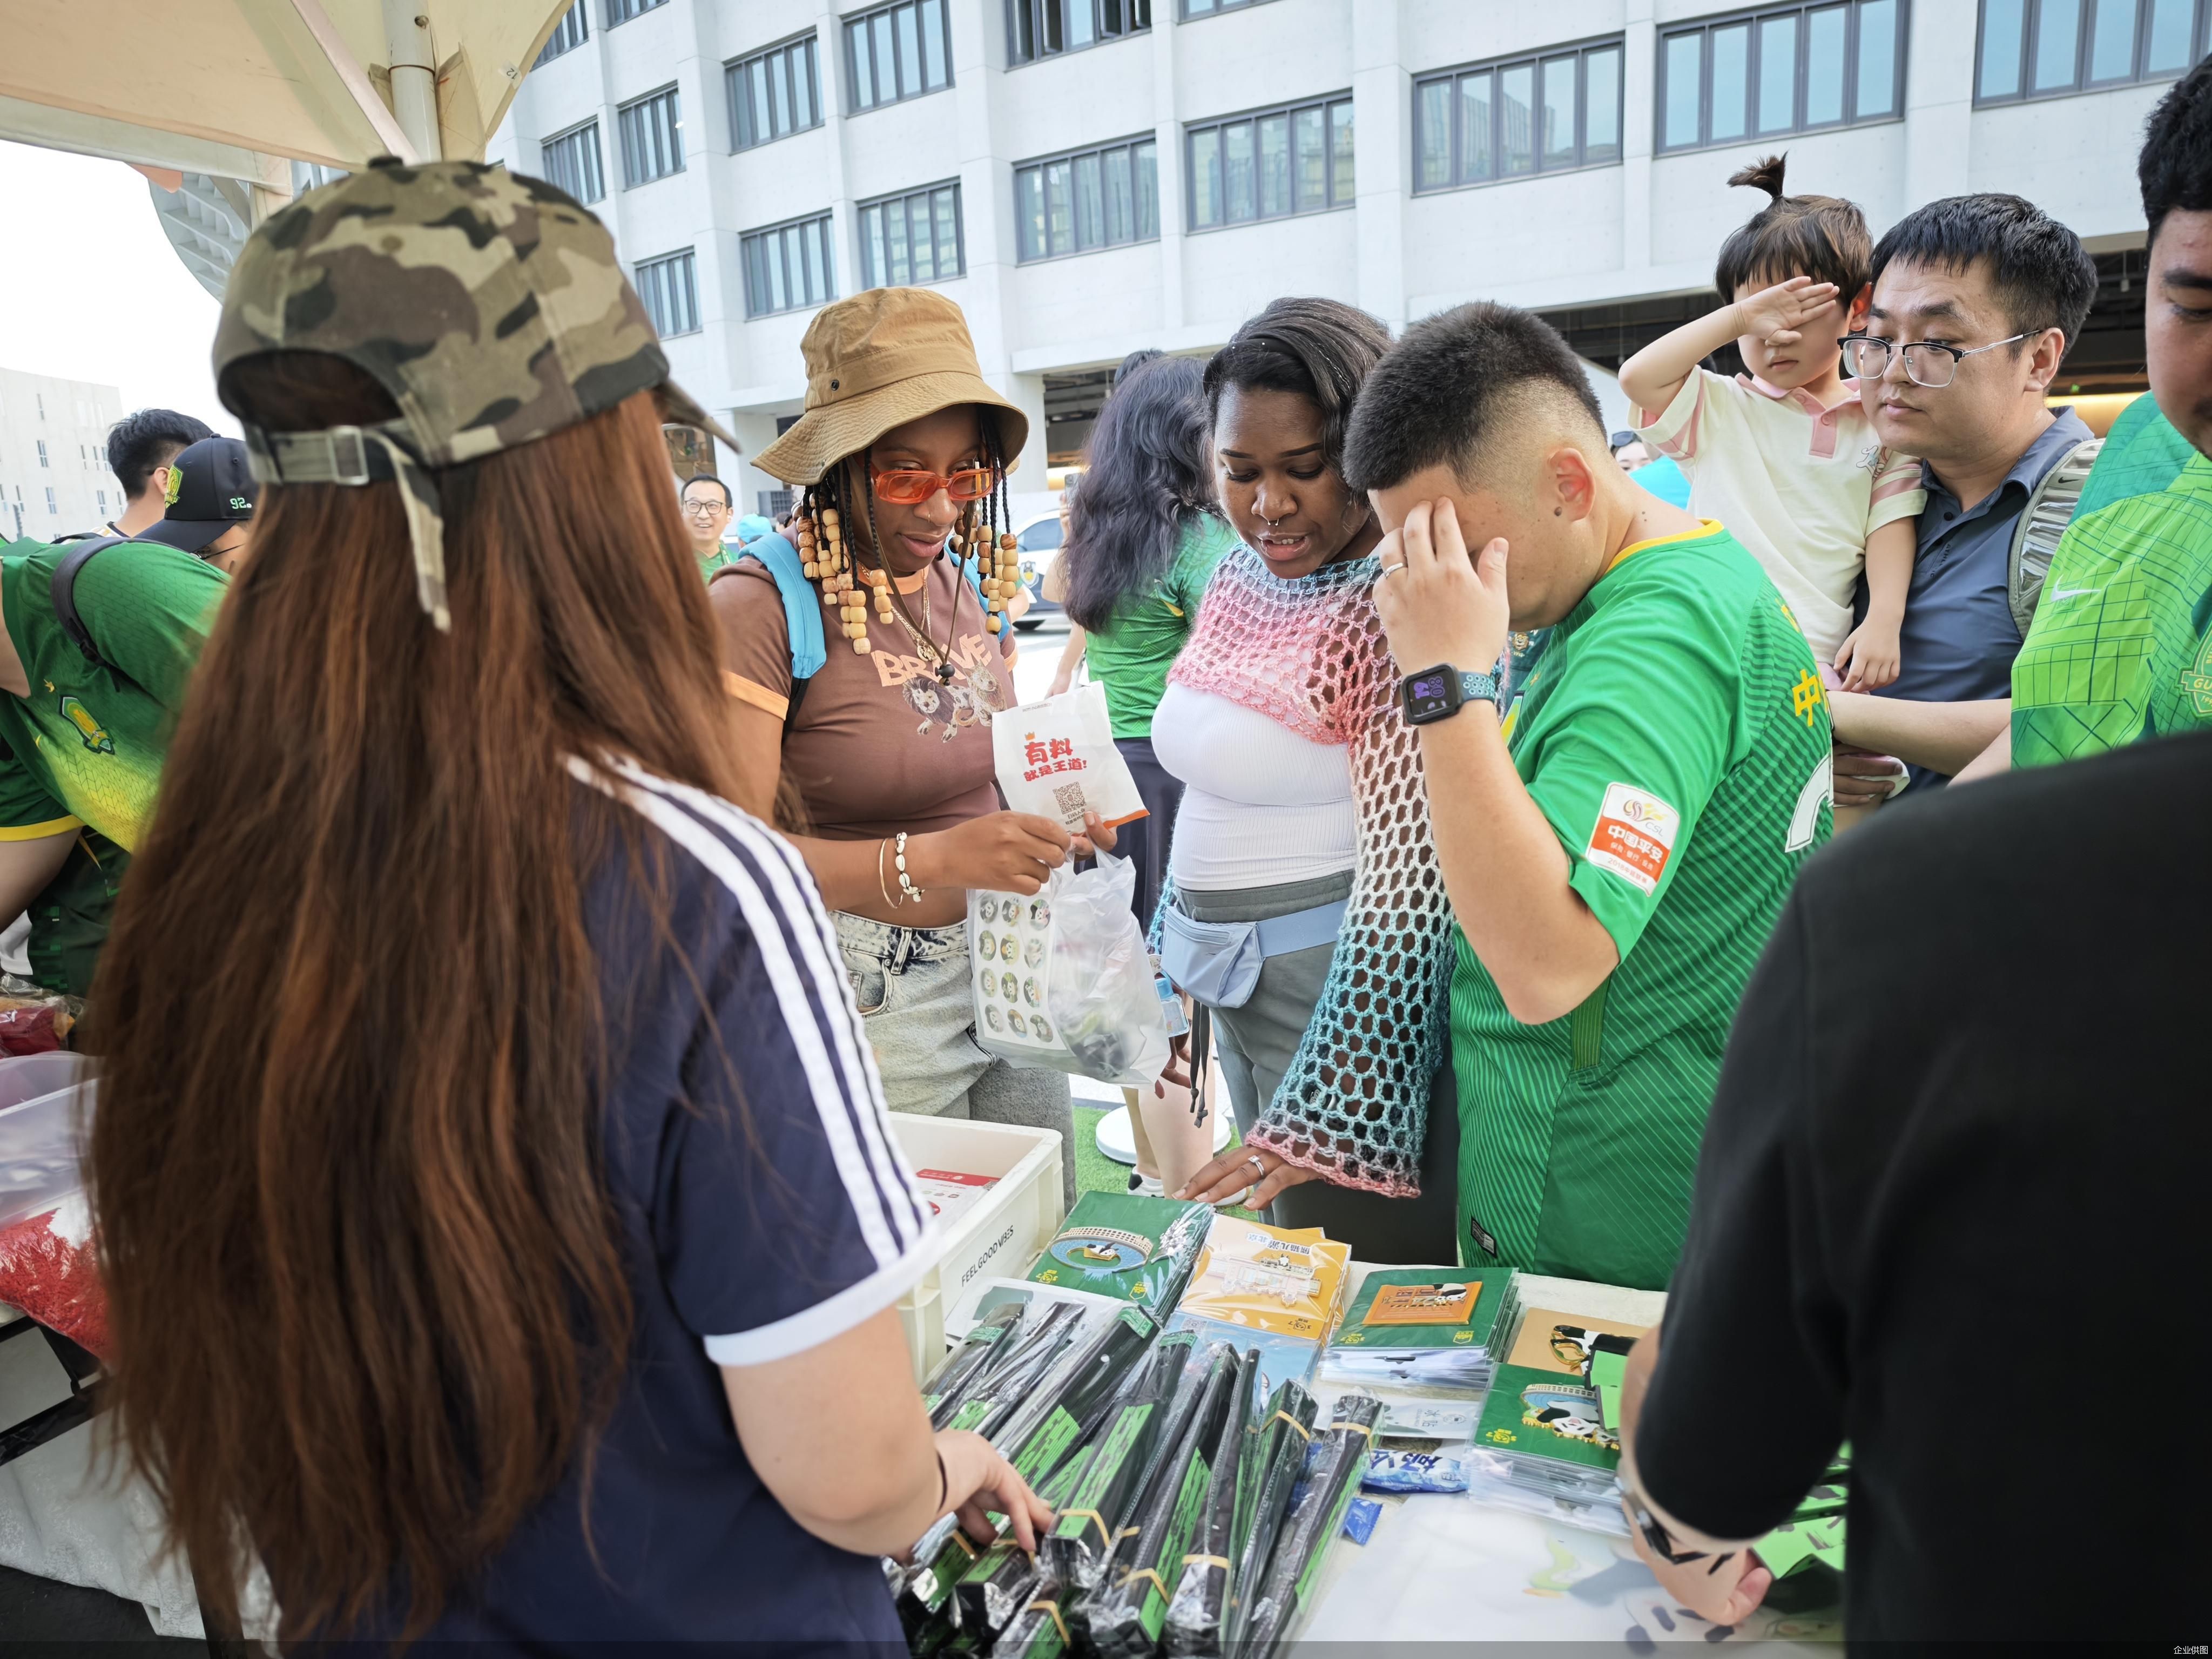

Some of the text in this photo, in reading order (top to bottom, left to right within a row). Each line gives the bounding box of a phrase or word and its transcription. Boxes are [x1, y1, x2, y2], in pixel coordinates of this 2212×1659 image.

[1930, 543, 1951, 577] ATHLIC
[1024, 737, 1073, 766] 有料
[1023, 758, 1087, 781] 就是王道!
[1607, 825, 1663, 864] 中国平安
[1645, 821, 1663, 837] CSL
[962, 1225, 1014, 1287] FEEL GOOD VIBES
